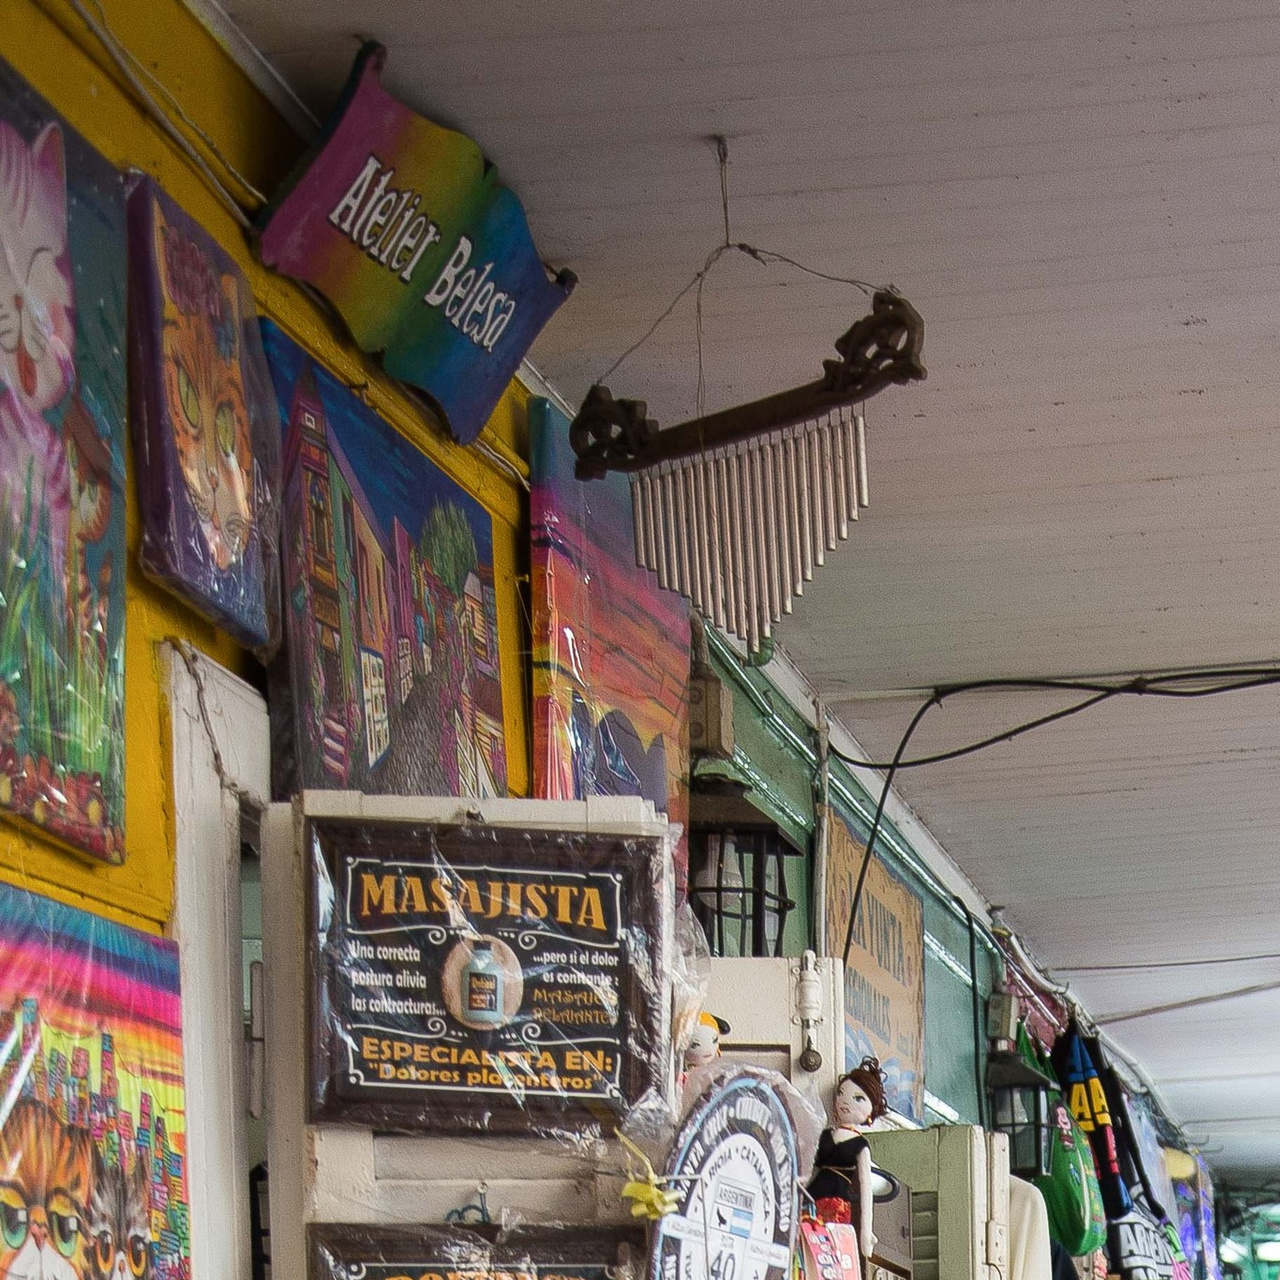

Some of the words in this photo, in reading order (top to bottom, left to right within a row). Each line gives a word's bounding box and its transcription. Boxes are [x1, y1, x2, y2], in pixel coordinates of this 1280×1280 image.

[329, 155, 441, 285] Atelier
[424, 235, 518, 354] Belesa
[361, 873, 607, 931] MASAJISTA
[377, 944, 421, 962] correcta
[569, 950, 577, 964] si
[580, 950, 589, 965] el
[591, 951, 620, 967] dolor
[351, 968, 393, 988] postura
[396, 969, 427, 989] alivia
[351, 993, 367, 1012] las
[565, 1050, 614, 1073] EN:
[368, 1062, 460, 1083] "Dolores
[467, 1068, 604, 1090] plaentros"
